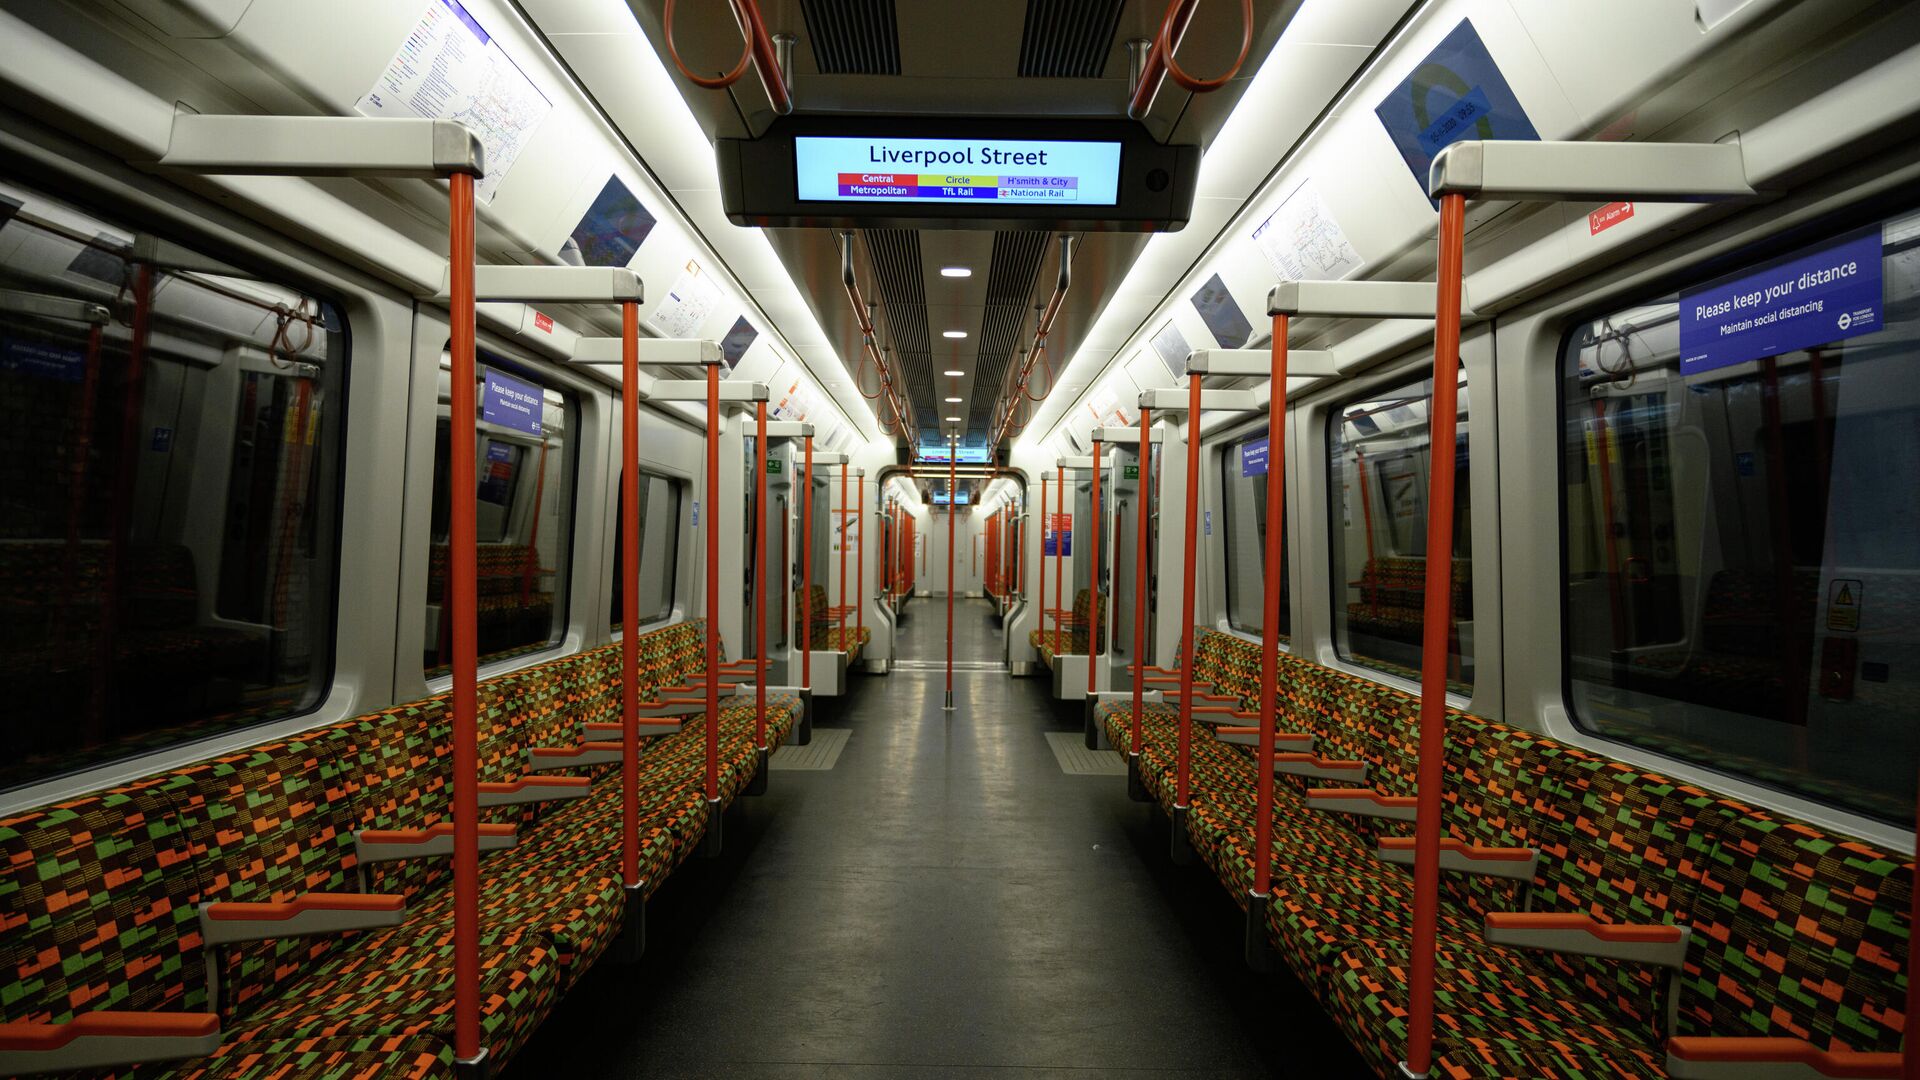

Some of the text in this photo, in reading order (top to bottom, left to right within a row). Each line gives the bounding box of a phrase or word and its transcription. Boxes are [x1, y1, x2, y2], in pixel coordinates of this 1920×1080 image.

[870, 145, 1048, 167] Liverpool Street
[862, 174, 894, 183] Central
[945, 176, 970, 185] Circle
[1007, 176, 1069, 187] H'smith & City
[850, 185, 907, 196] Metropolitan
[942, 187, 974, 196] TfL Rail
[1010, 188, 1065, 198] National Rail
[1696, 261, 1857, 321] Please keep your distance
[1720, 299, 1824, 336] Maintain social distancing
